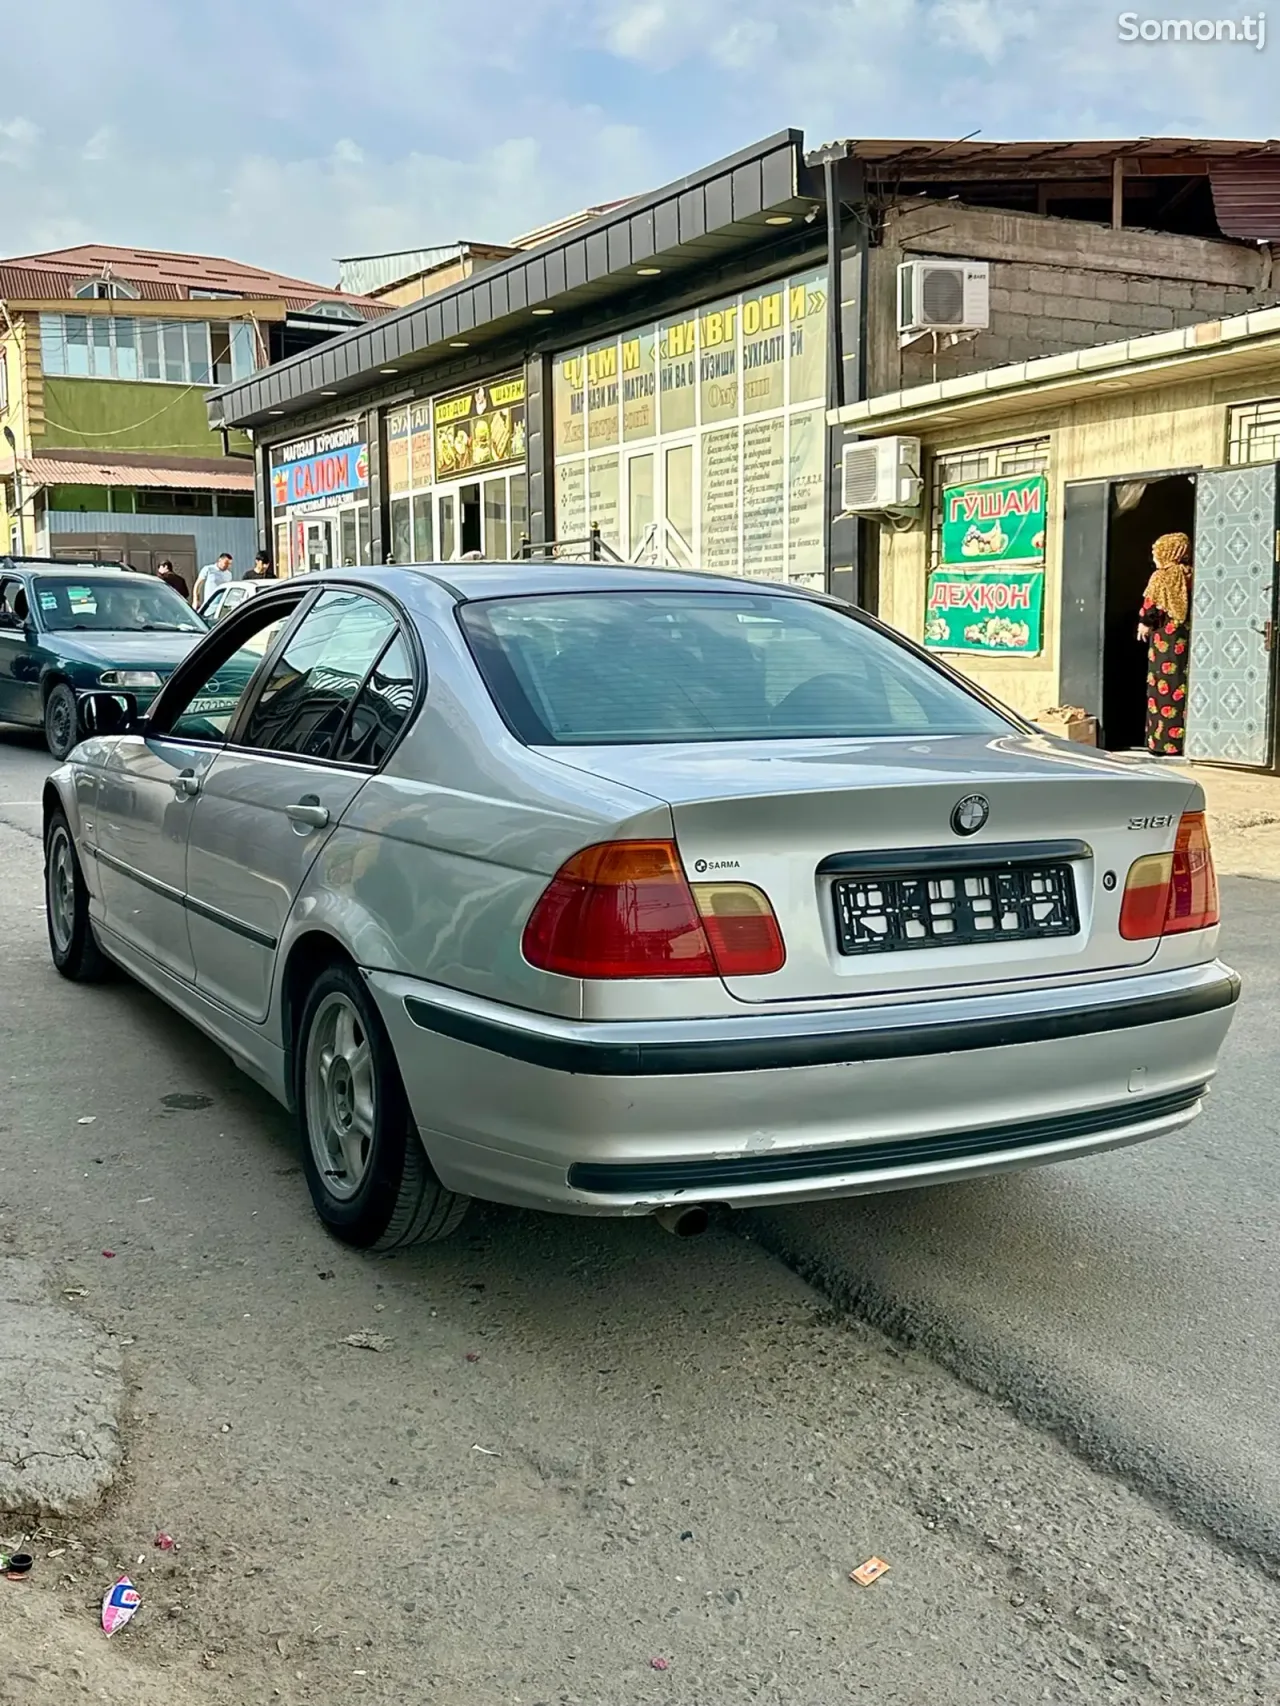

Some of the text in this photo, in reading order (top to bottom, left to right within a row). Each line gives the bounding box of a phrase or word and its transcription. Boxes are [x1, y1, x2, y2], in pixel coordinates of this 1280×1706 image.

[293, 453, 349, 499] САЛОМ
[951, 487, 1041, 523] ГӮШАИ
[708, 860, 741, 870] SARMA
